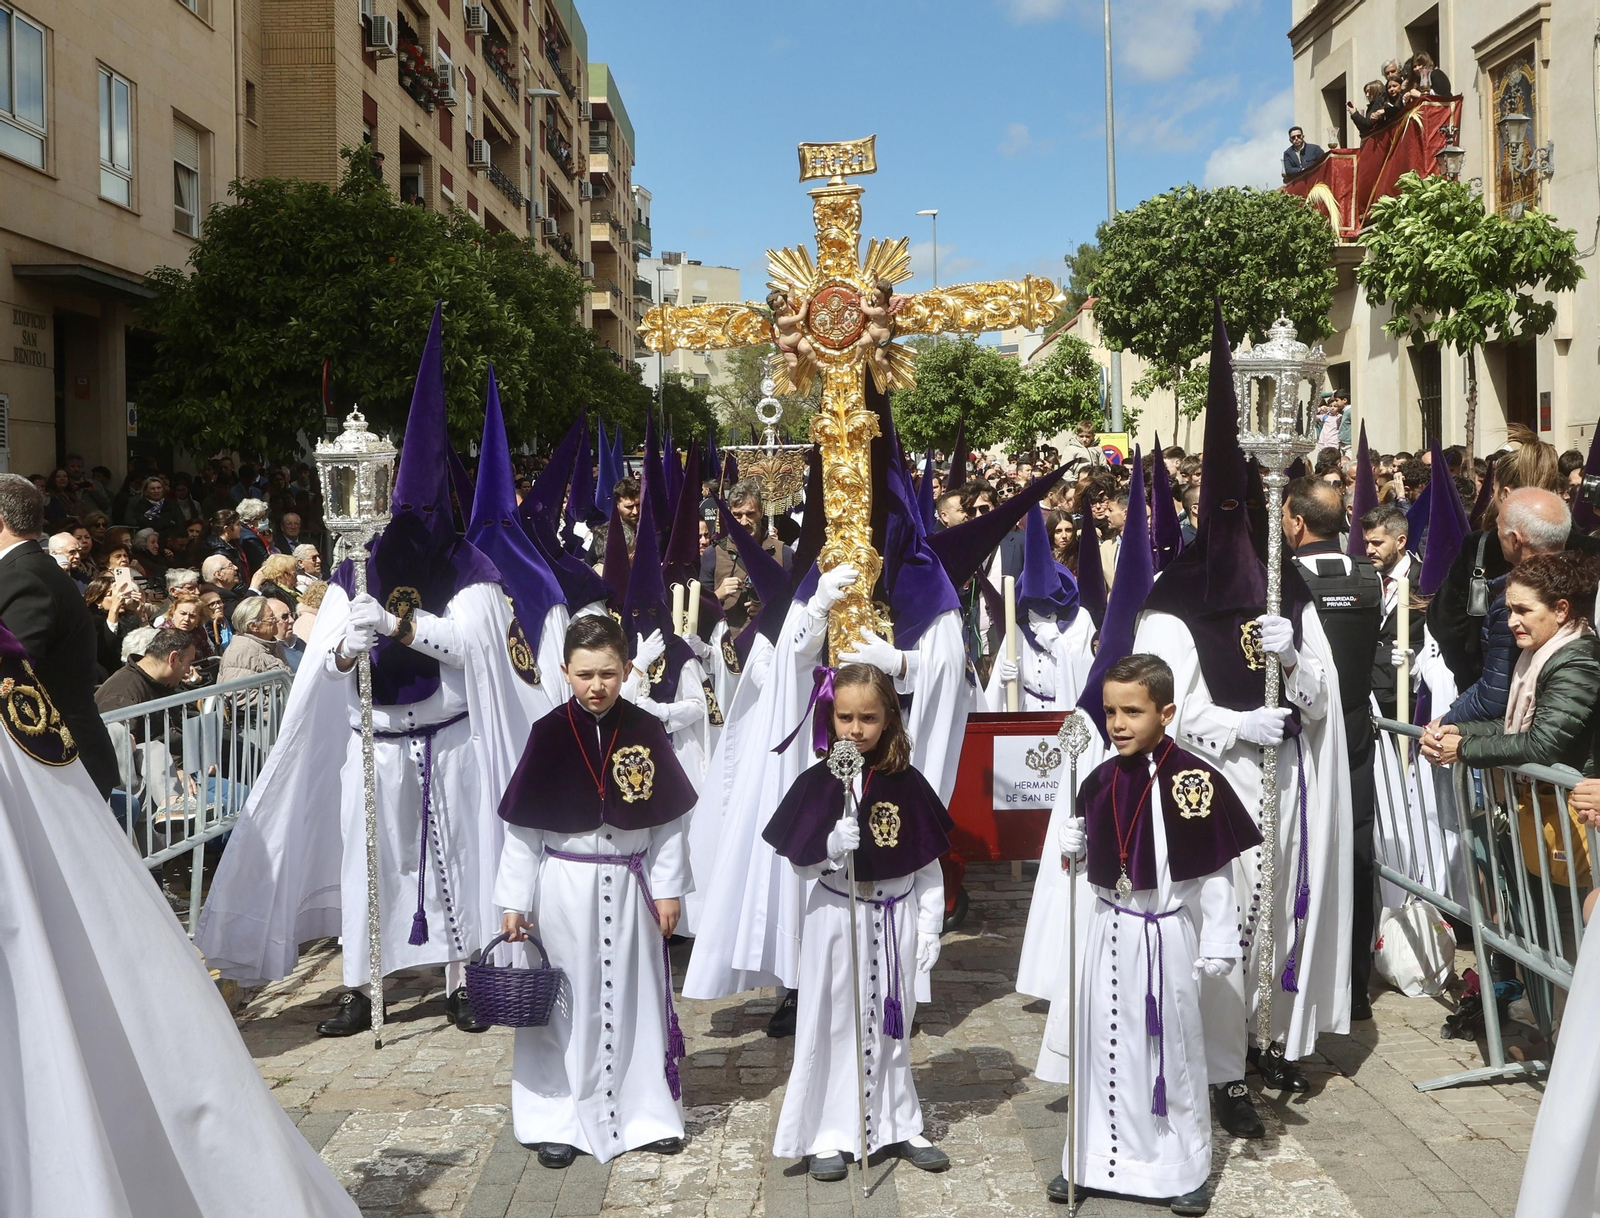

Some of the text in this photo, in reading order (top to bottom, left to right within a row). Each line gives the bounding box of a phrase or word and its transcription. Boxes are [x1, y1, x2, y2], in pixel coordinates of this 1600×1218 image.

[13, 309, 46, 330] EDIFICIO
[22, 330, 37, 347] SAN
[13, 346, 42, 366] BENITO
[1014, 781, 1059, 790] HERMAND
[1005, 793, 1056, 802] DE SAN BE
